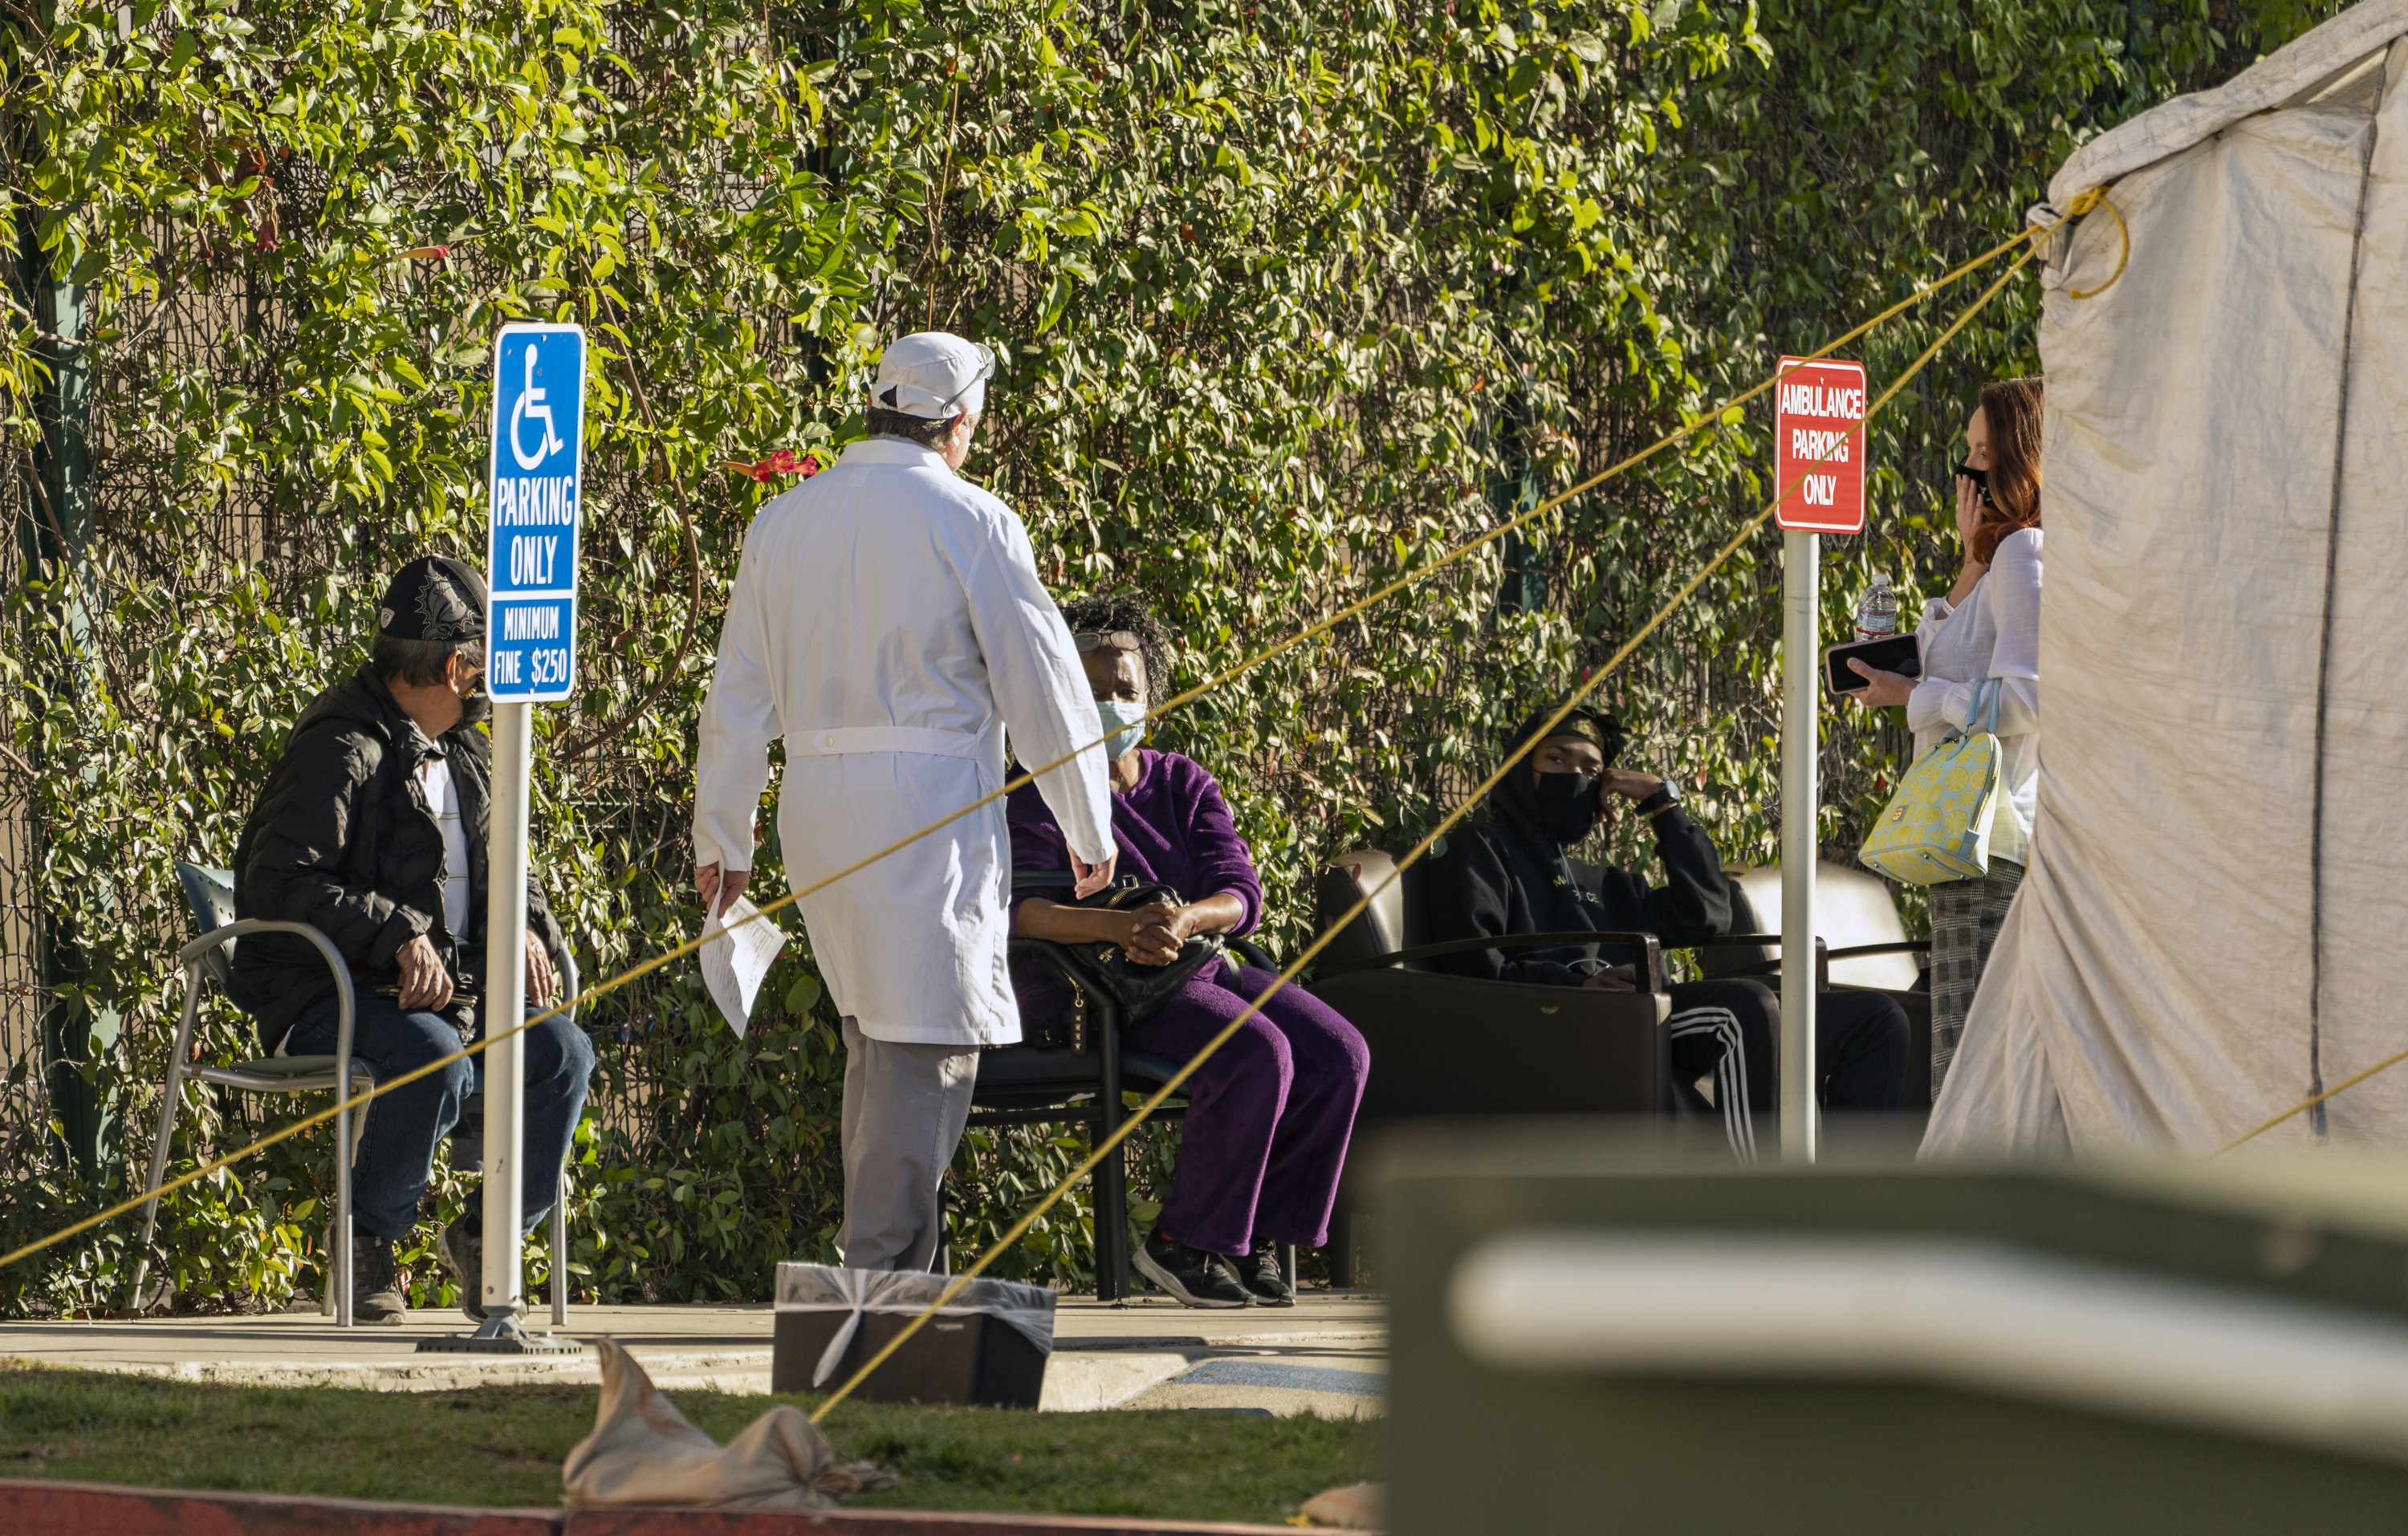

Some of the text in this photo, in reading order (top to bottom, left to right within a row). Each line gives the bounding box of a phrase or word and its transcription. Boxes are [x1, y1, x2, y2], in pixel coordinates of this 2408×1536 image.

[1780, 384, 1862, 420] AMBULANCE
[1792, 428, 1849, 463] PARKING
[497, 474, 574, 526] PARKING
[1803, 473, 1837, 506] ONLY
[510, 534, 558, 586] ONLY
[504, 606, 559, 641] MINIMUM
[494, 647, 567, 688] FINE $250
